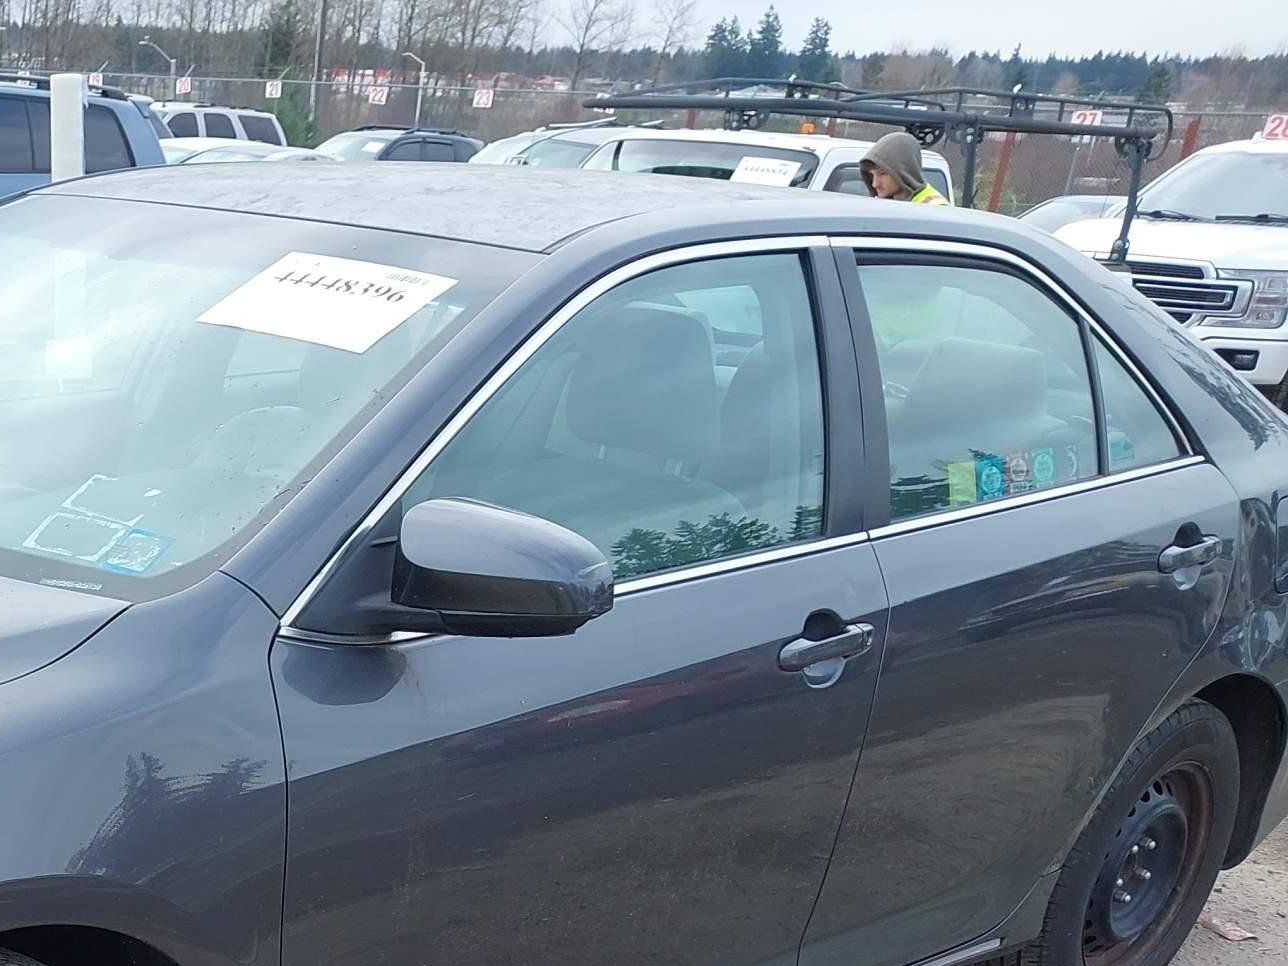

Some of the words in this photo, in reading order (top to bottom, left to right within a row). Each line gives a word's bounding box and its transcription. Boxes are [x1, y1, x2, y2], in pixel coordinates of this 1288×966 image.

[178, 78, 190, 93] 20
[268, 81, 279, 97] 21
[371, 87, 385, 103] 22
[475, 90, 490, 106] 23
[274, 271, 406, 302] 44448396
